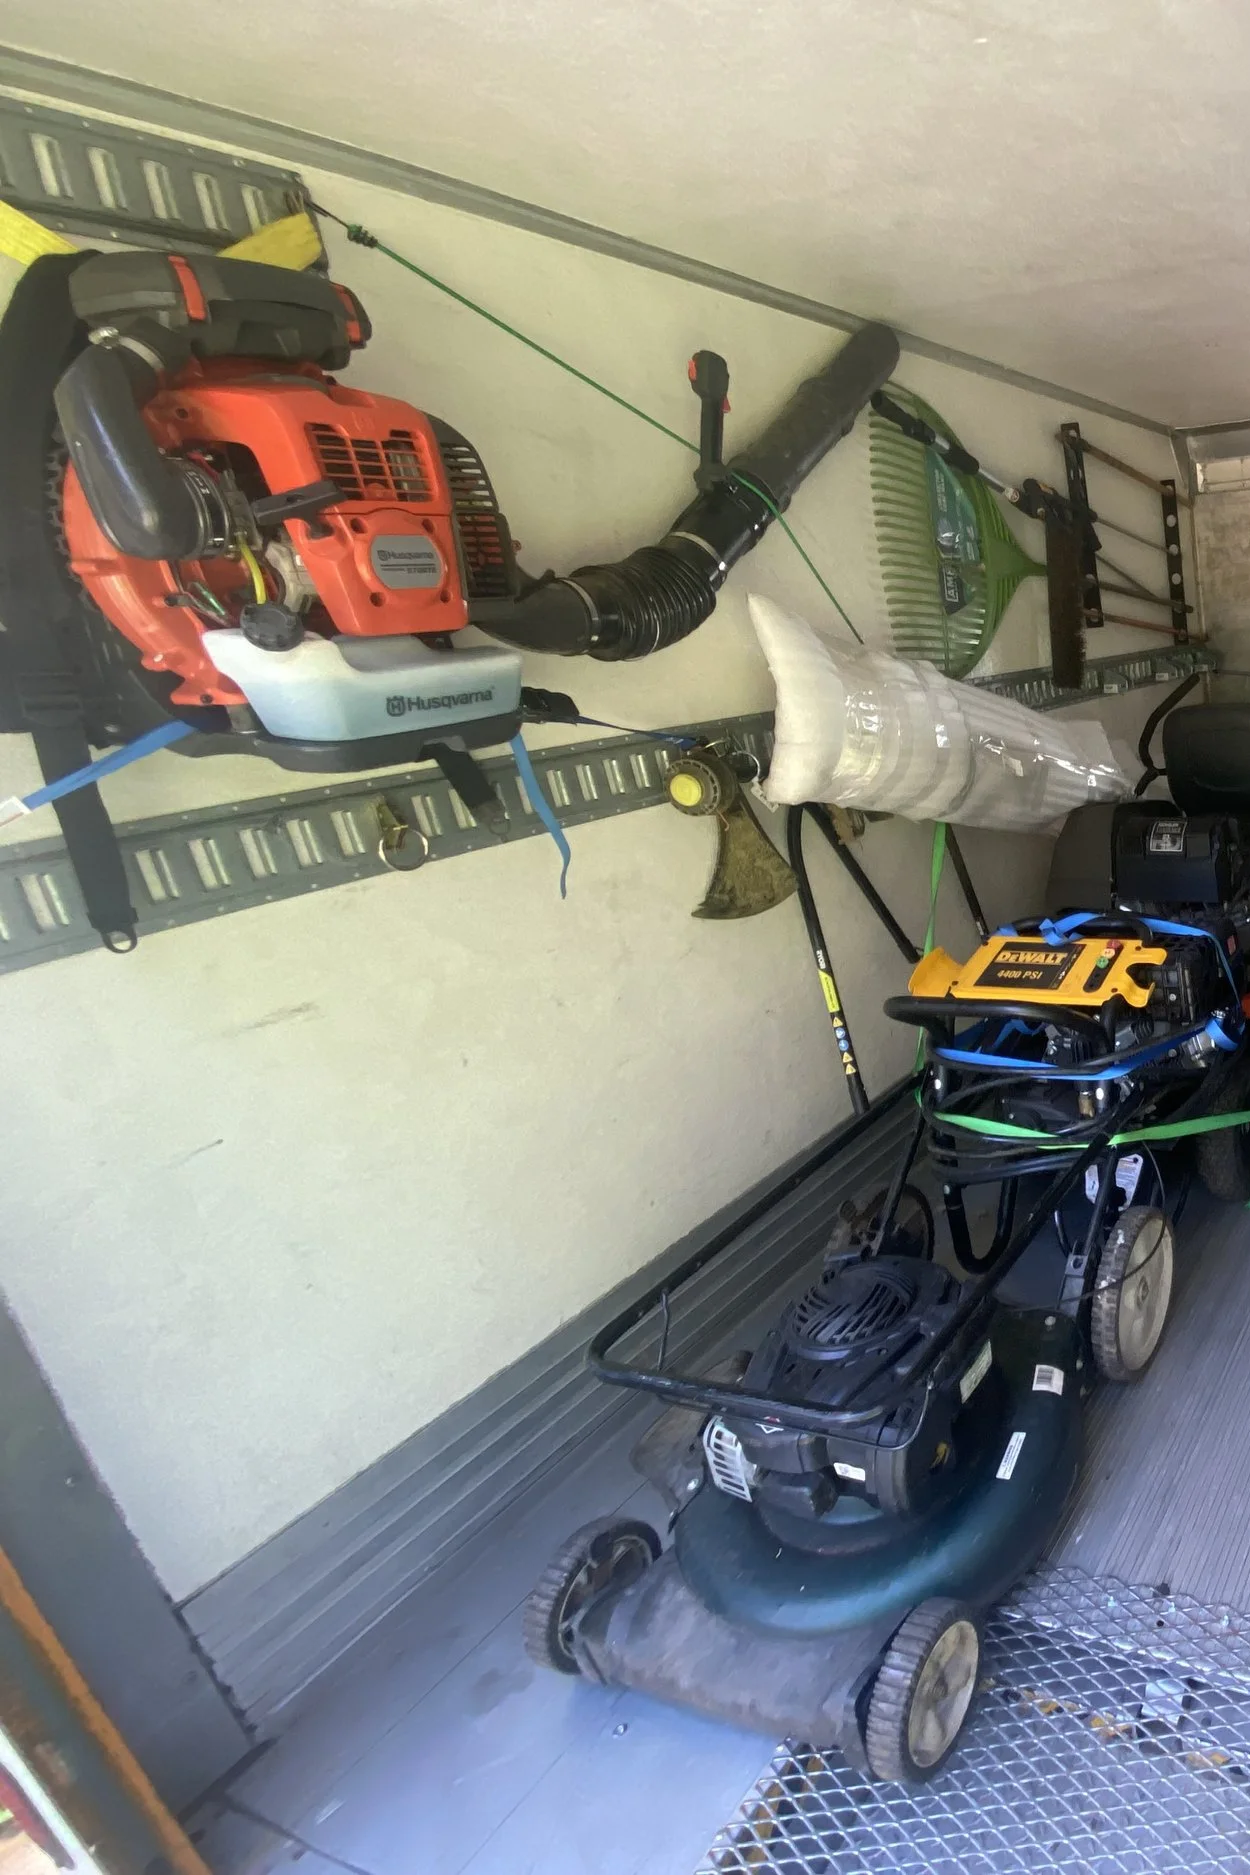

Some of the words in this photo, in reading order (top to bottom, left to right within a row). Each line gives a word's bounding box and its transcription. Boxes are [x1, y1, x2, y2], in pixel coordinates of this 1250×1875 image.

[407, 689, 493, 712] Husqvarna
[997, 970, 1021, 978] 4400
[1022, 970, 1044, 980] PSI
